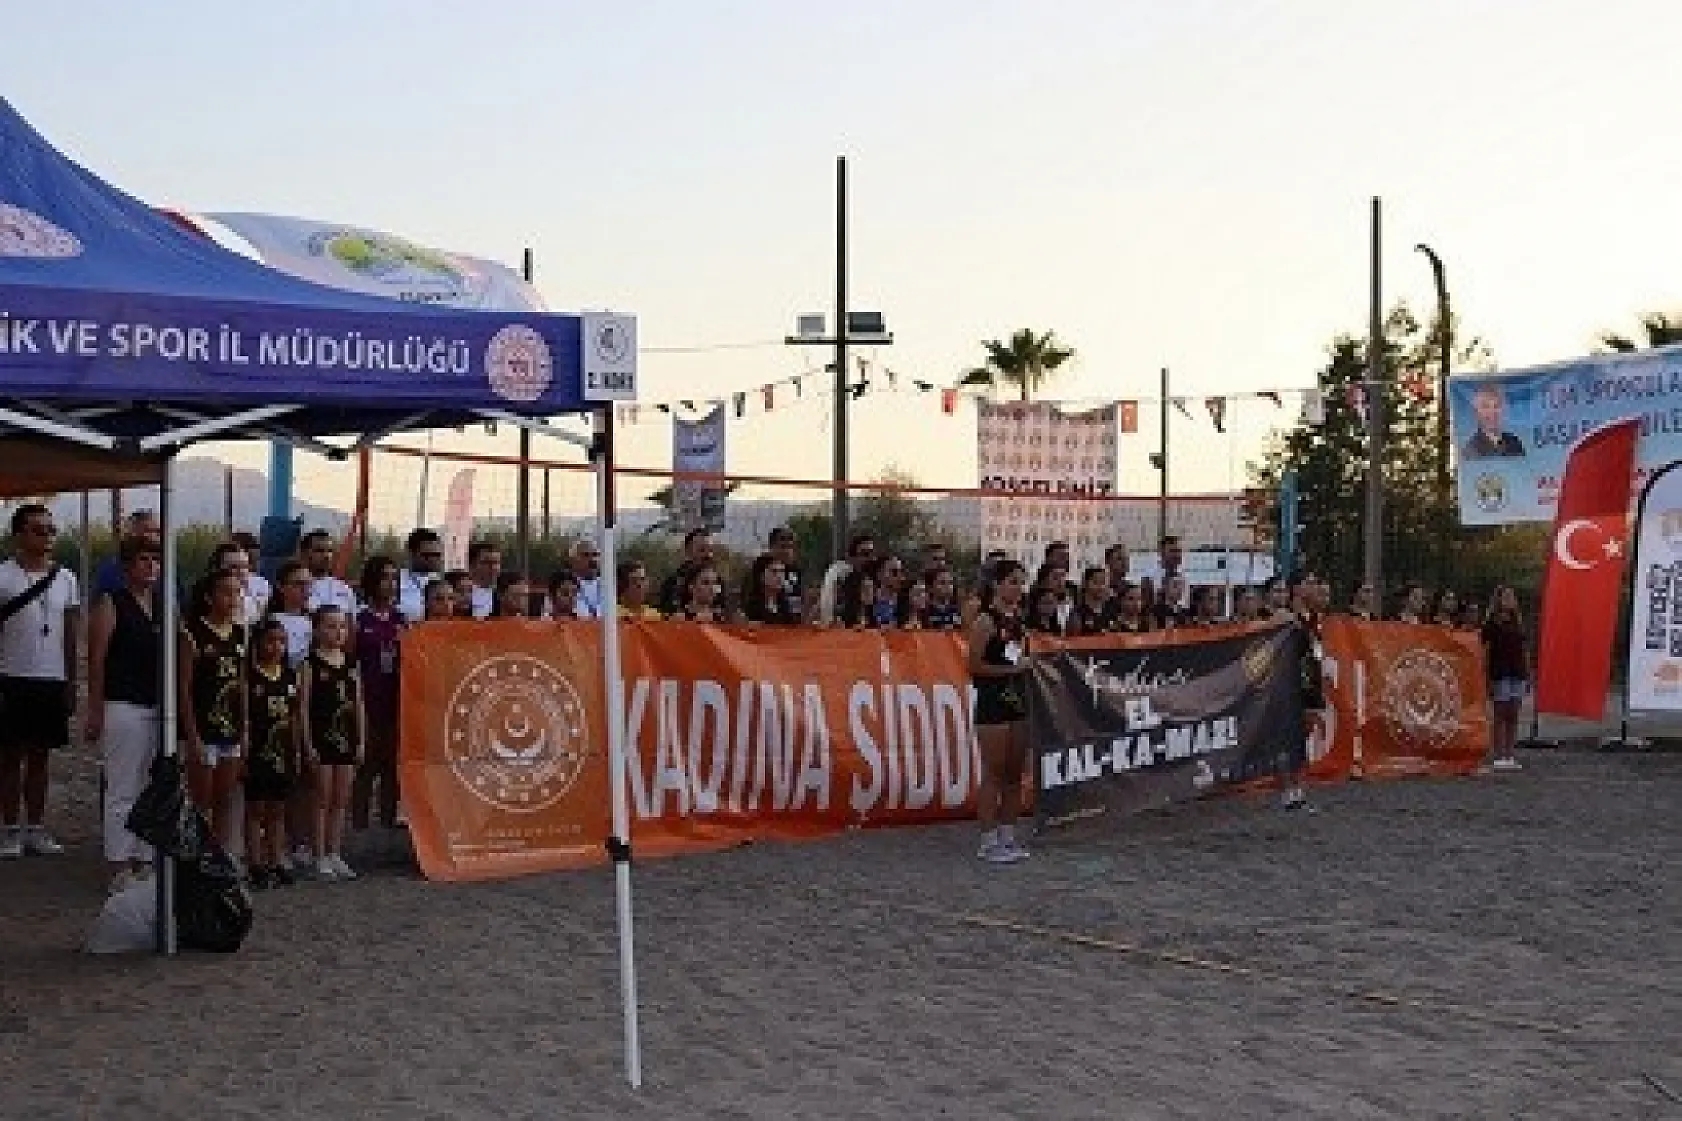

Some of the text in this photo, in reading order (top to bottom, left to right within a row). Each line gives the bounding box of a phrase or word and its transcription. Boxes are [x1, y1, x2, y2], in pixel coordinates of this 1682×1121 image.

[48, 319, 99, 355] VE
[108, 323, 209, 362] SPOR
[219, 323, 249, 364] İL
[259, 327, 470, 374] MÜDÜRLÜĞÜ
[1124, 696, 1163, 730] EL
